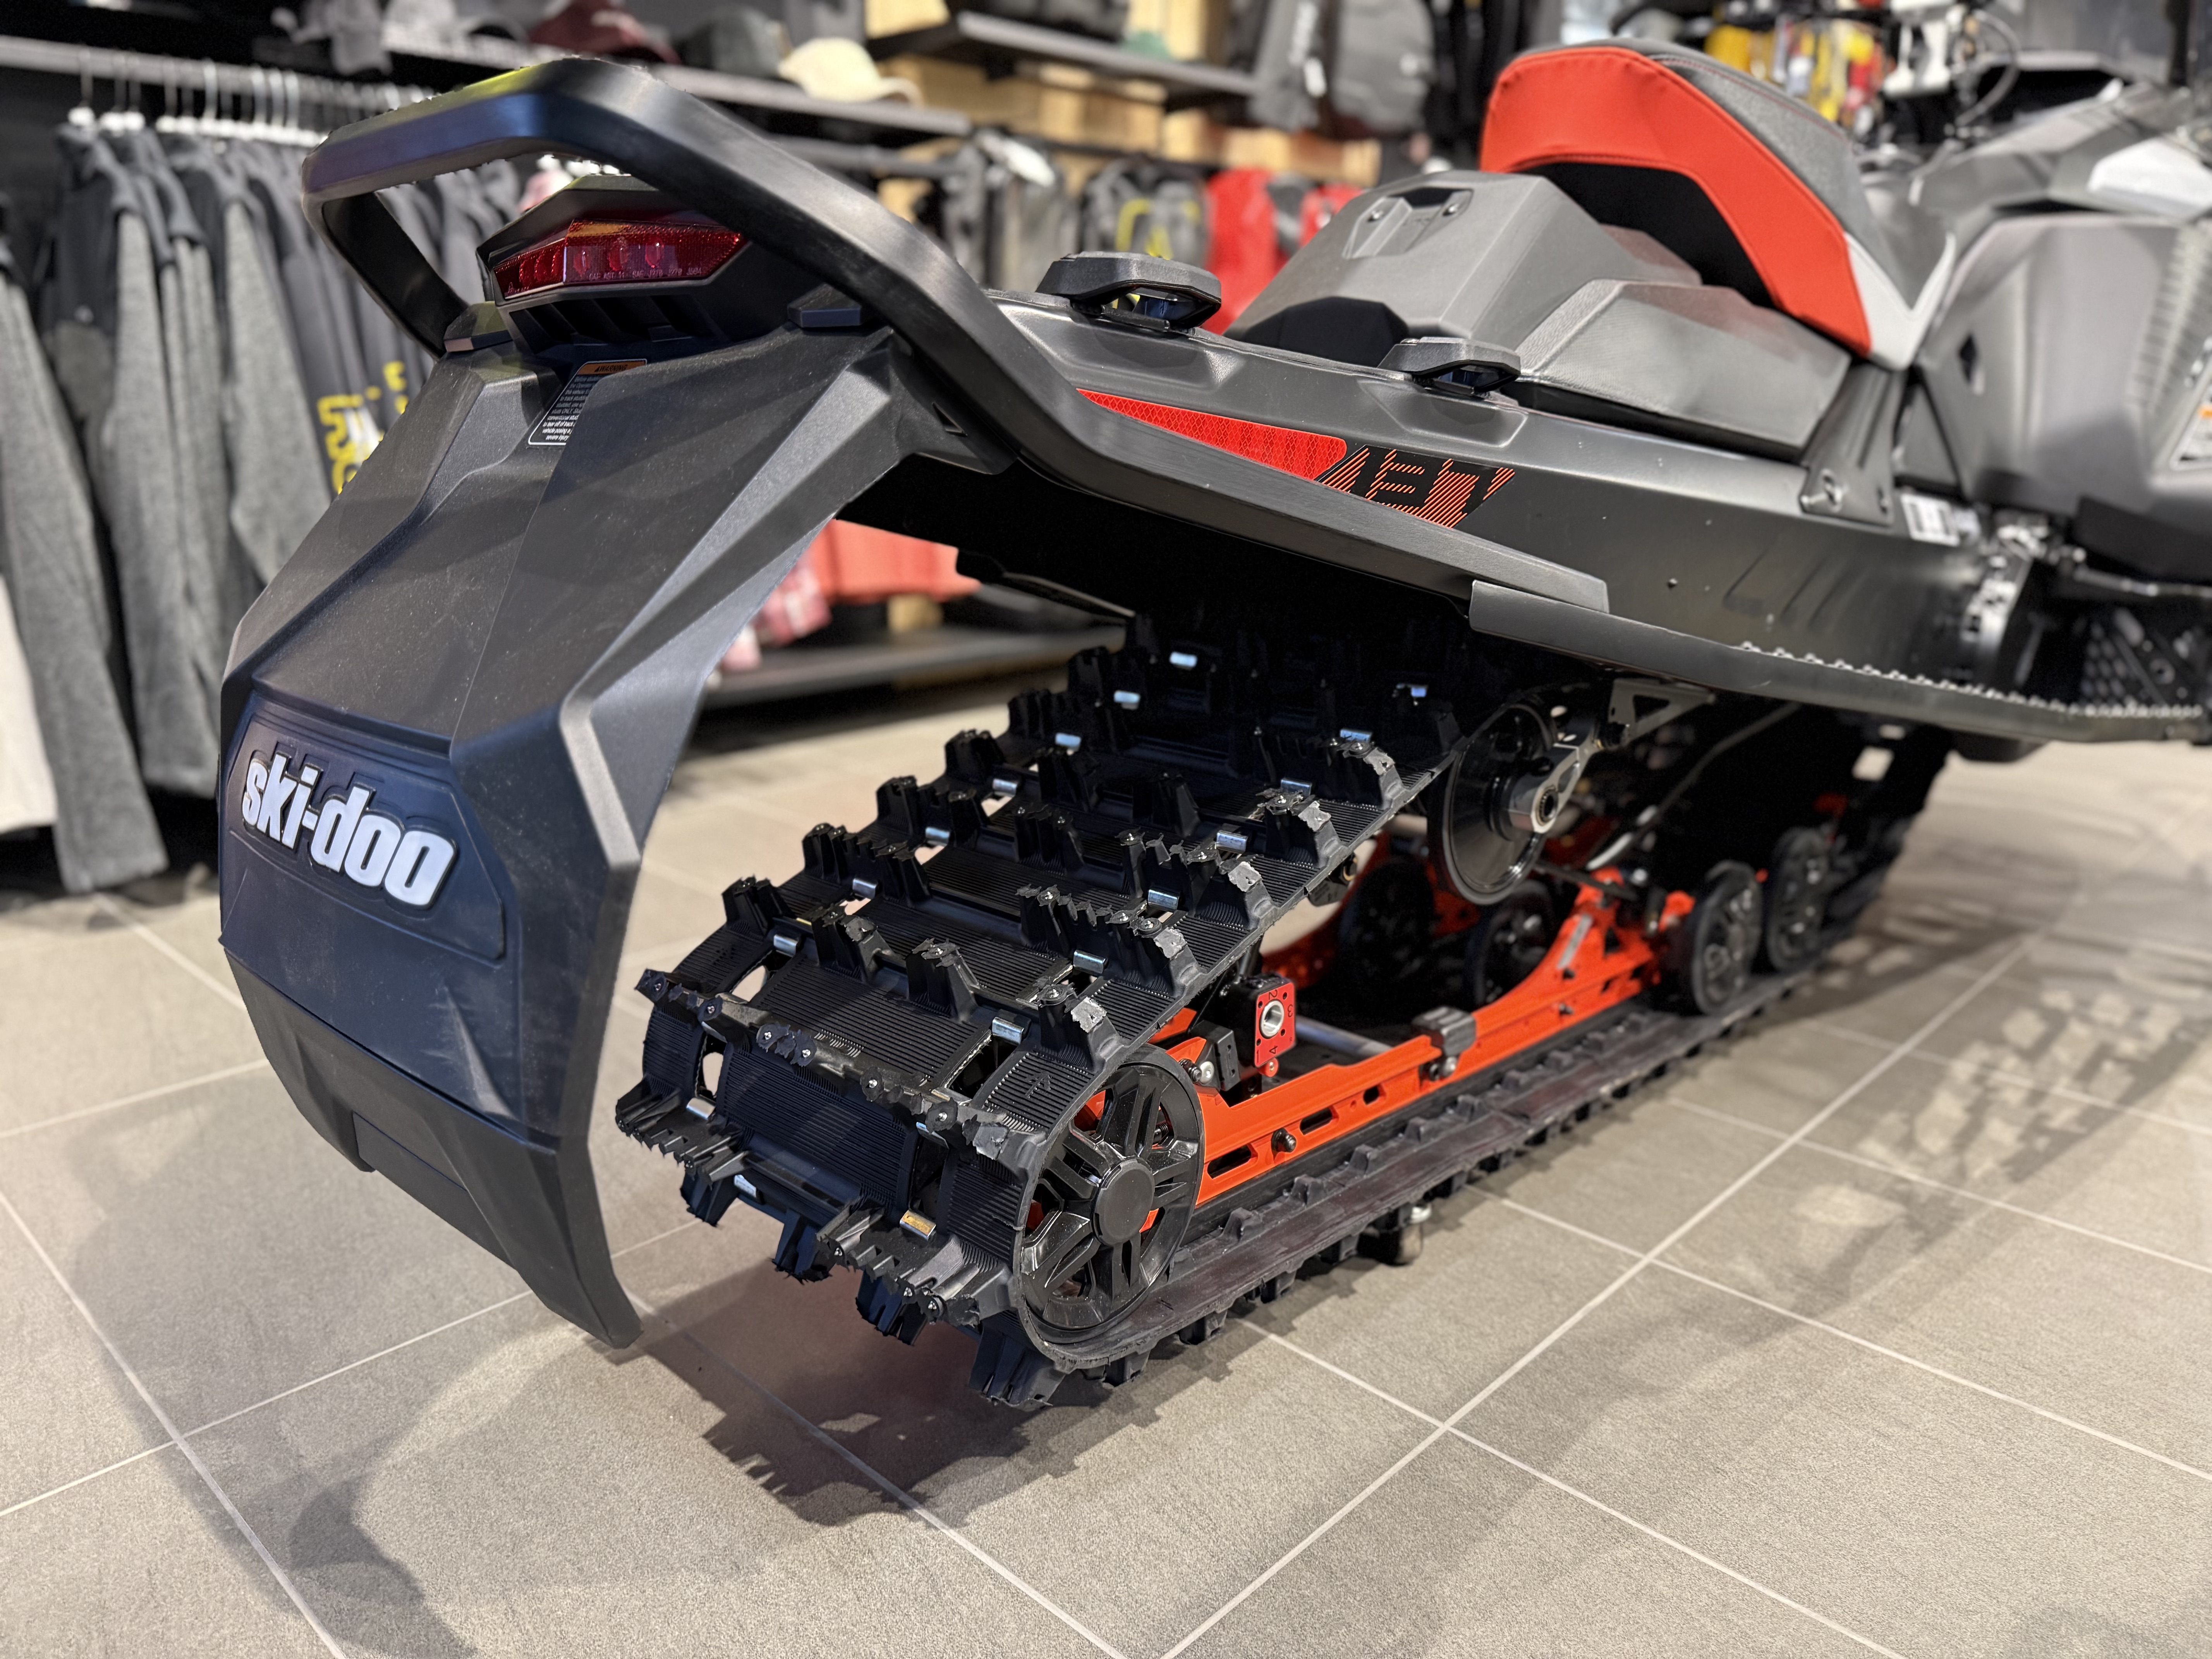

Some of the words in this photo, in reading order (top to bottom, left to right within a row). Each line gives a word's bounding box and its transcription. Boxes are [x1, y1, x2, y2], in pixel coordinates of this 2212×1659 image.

[598, 364, 628, 373] WARNING
[242, 753, 455, 907] ski-doo
[1269, 989, 1278, 1000] 2
[1287, 1004, 1293, 1018] 3
[1269, 1045, 1278, 1054] 4
[1256, 1050, 1259, 1063] 1
